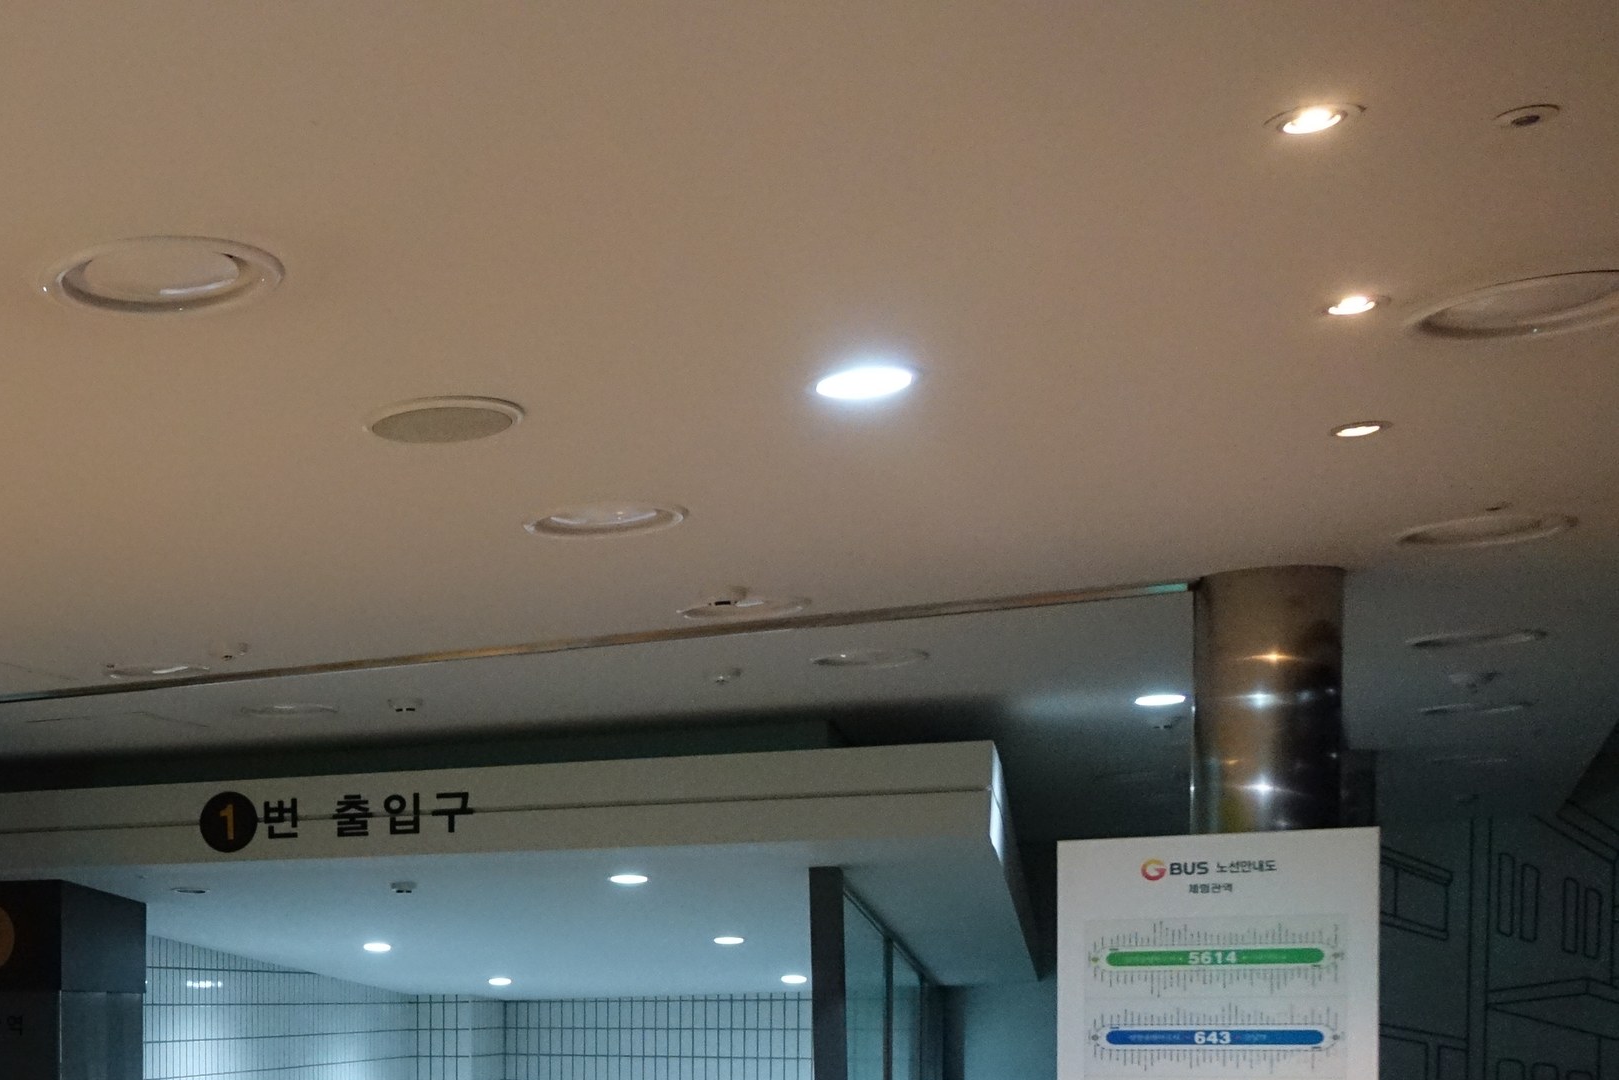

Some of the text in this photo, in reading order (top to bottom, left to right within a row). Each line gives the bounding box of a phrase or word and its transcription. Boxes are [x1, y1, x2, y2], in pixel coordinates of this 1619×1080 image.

[332, 791, 474, 838] 출입구
[1216, 859, 1277, 874] 노선안내도
[1188, 951, 1238, 965] 5614
[1193, 1031, 1231, 1045] 643
